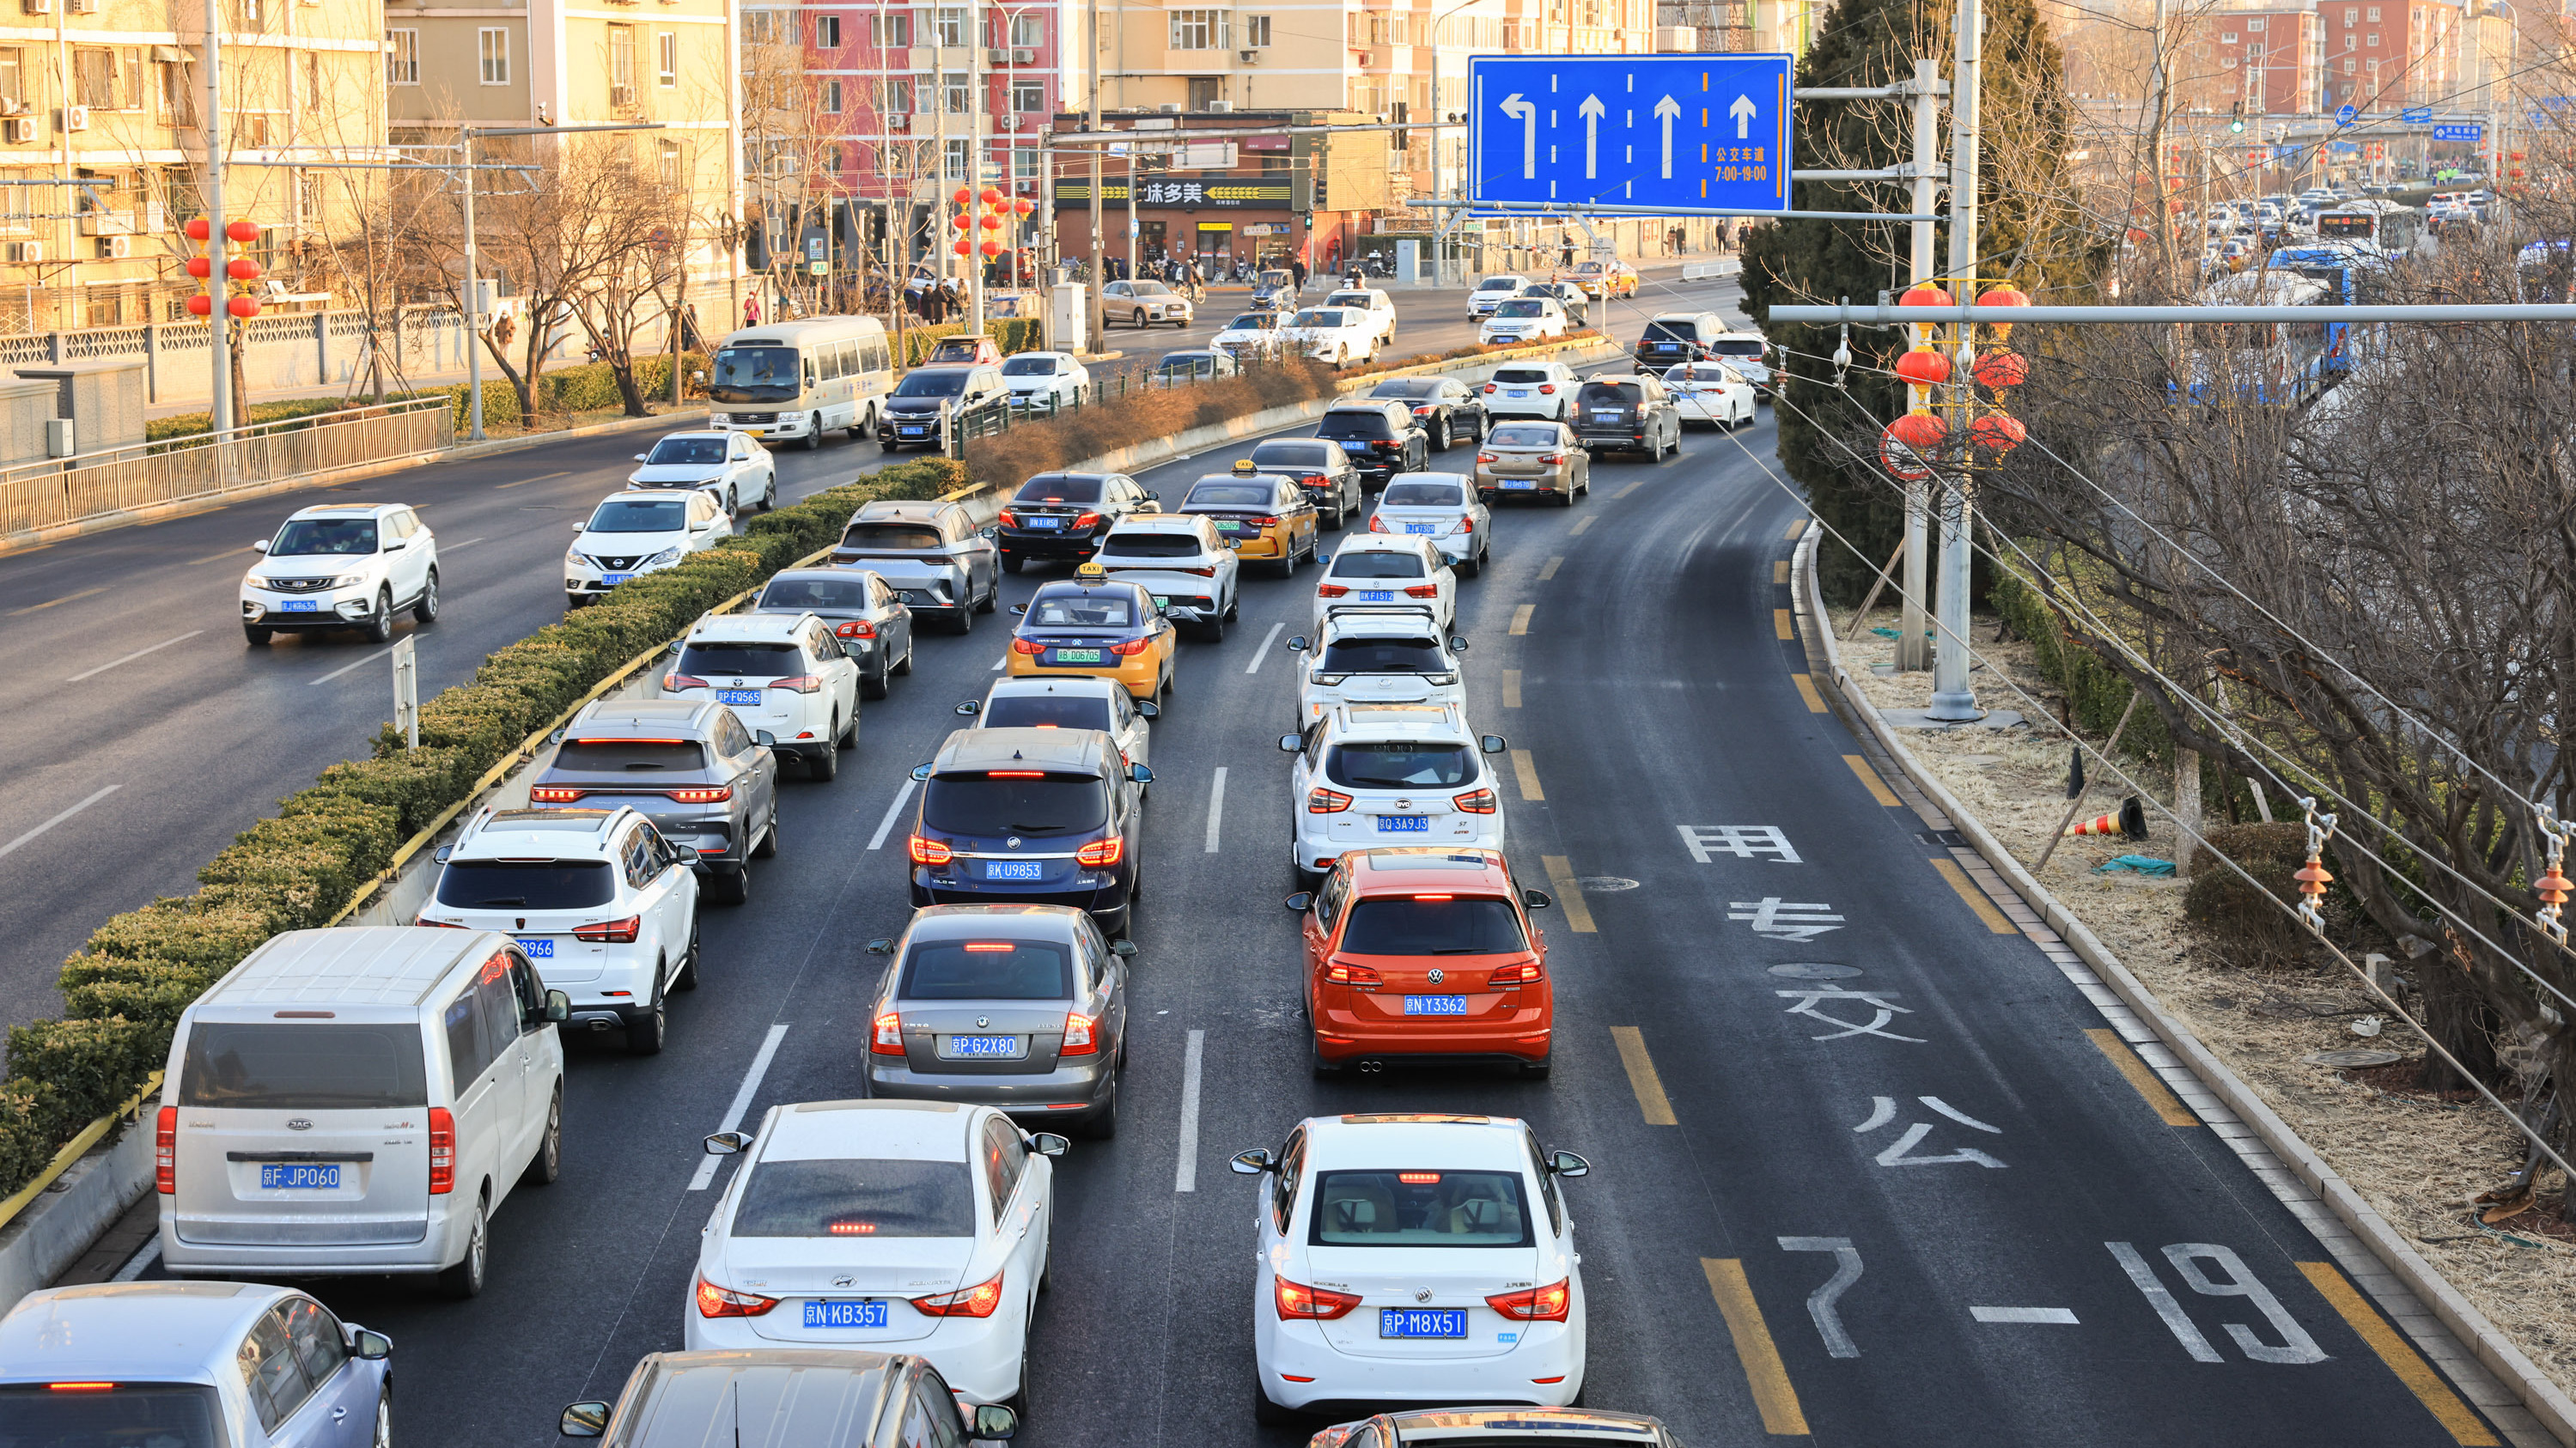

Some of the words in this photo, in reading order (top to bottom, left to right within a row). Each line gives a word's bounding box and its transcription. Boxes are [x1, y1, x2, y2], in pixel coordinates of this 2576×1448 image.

[1715, 147, 1765, 162] 公交车道
[1714, 166, 1767, 182] 7:00-19:00
[1144, 183, 1202, 204] 味多美
[518, 942, 552, 956] 8966
